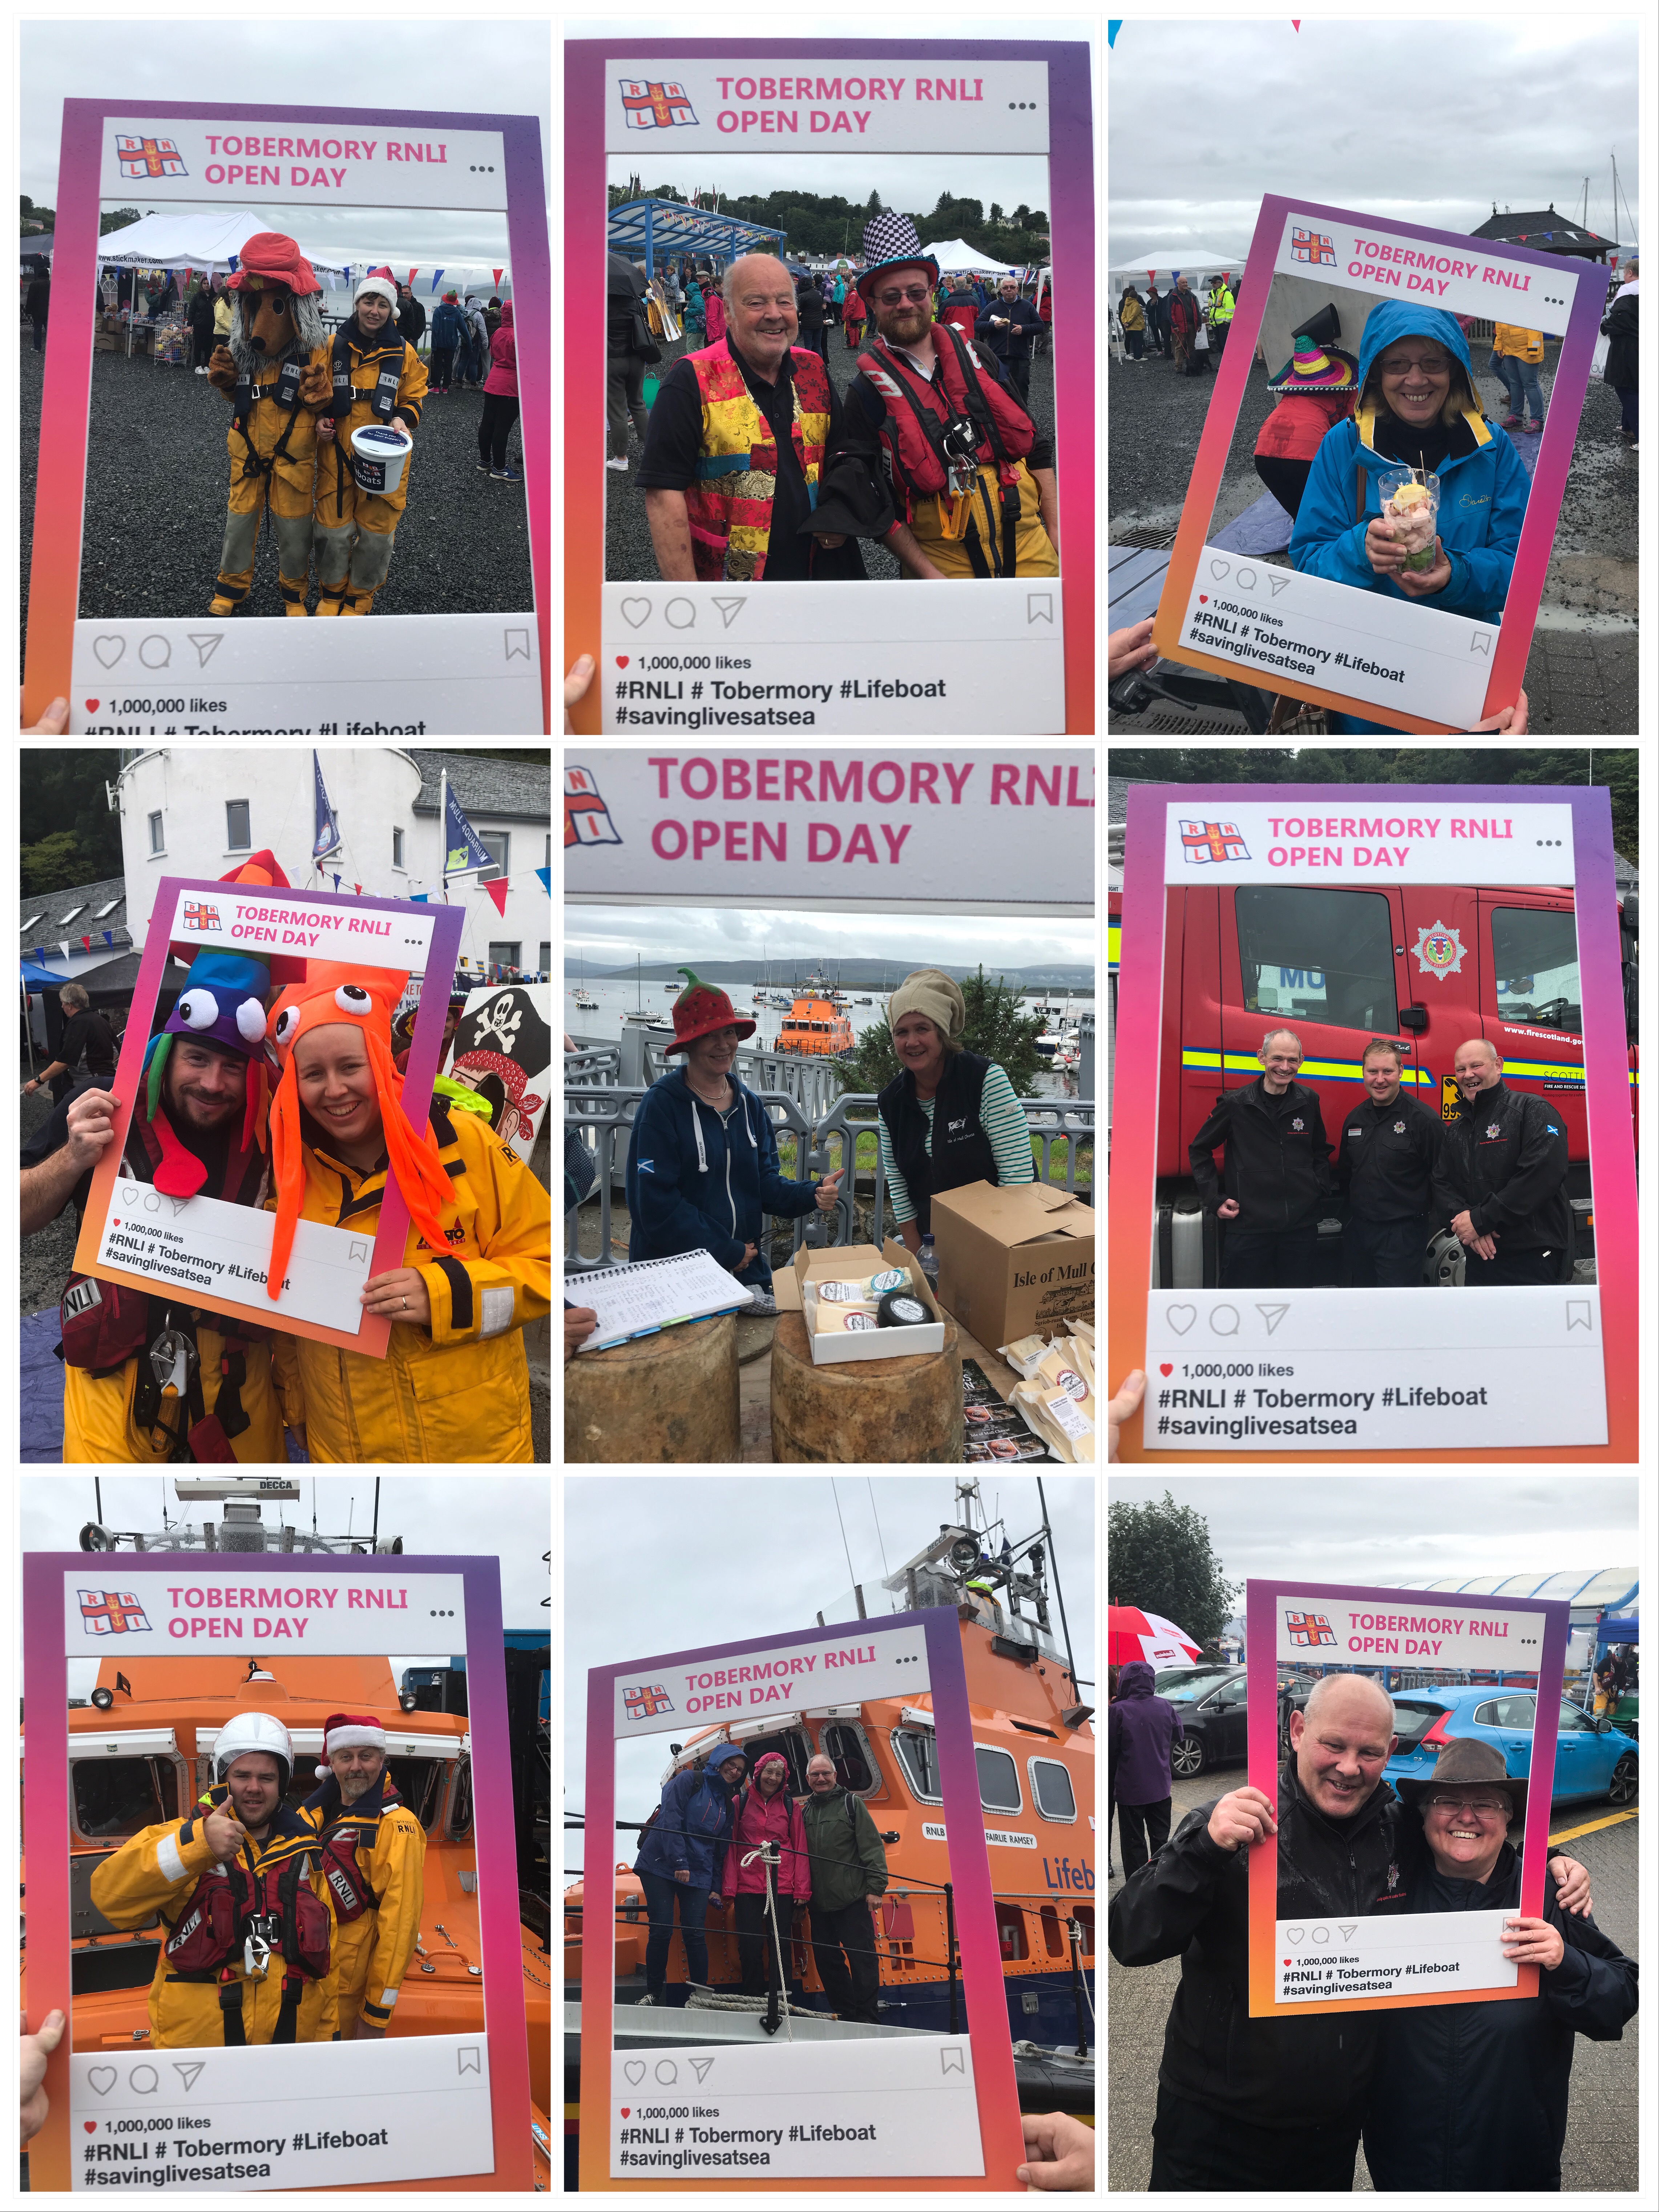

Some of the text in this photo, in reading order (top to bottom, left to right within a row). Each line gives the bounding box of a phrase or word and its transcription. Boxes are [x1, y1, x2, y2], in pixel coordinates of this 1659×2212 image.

[716, 77, 983, 101] TOBERMORY RNLI
[716, 110, 872, 133] OPEN DAY
[206, 136, 447, 163] TOBERMORY RNLI
[205, 165, 347, 187] OPEN DAY
[1354, 239, 1531, 291] TOBERMORY RNLI
[1348, 262, 1450, 296] OPEN DAY
[1213, 599, 1283, 627] 1,000,000 likes
[1190, 628, 1315, 675] #savinglivesatsea
[1194, 611, 1405, 683] #RNLI # Tobermory #Lifeboat
[638, 655, 751, 670] 1,000,000 likes
[615, 678, 946, 701] #RNLI # Tobermory #Lifeboat
[109, 698, 227, 713] 1,000,000 likes
[615, 705, 815, 729] #savinglivesatsea
[648, 758, 1095, 806] TOBERMORY RNL
[449, 800, 488, 863] MULL AQUARIUM
[1268, 818, 1513, 838] TOBERMORY RNLI
[651, 819, 911, 864] OPEN DAY
[1268, 847, 1410, 867] OPEN DAY
[236, 905, 392, 936] TOBERMORY RNLI
[231, 924, 320, 946] OPEN DAY
[125, 1222, 183, 1243] 1,000,000 likes
[109, 1232, 144, 1251] #RNLI
[148, 1243, 155, 1253] #
[158, 1245, 225, 1274] Tobermory
[106, 1247, 212, 1285] #savinglivesatsea
[1013, 1263, 1087, 1288] Isle of Mull
[1182, 1363, 1294, 1378] 1,000,000 likes
[1158, 1385, 1487, 1410] #RNLI # Tobermory #Lifeboat
[1157, 1416, 1357, 1438] #savinglivesatsea
[167, 1588, 408, 1610] TOBERMORY RNLI
[167, 1618, 309, 1639] OPEN DAY
[1348, 1613, 1508, 1638] TOBERMORY RNLI
[1348, 1636, 1442, 1656] OPEN DAY
[685, 1645, 876, 1691] TOBERMORY RNLI
[686, 1682, 793, 1714] OPEN DAY
[397, 1825, 415, 1834] RNLI
[926, 1826, 1033, 1846] RNLB FAIRLIE RAMSEY
[332, 1872, 355, 1906] RNLI
[172, 1914, 197, 1948] RNLI
[1283, 1962, 1460, 1983] #RNLI # Tobermory #Lifeboat
[1296, 1957, 1337, 1967] 1,000,000
[1283, 1980, 1392, 1995] #savinglivesatsea
[637, 2106, 719, 2120] 1,000,000 likes
[104, 2116, 211, 2134] 1,000,000 likes
[620, 2124, 876, 2145] #RNLI # Tobermory #Lifeboat
[85, 2130, 388, 2162] #RNLI # Tobermory #Lifeboat
[620, 2151, 770, 2170] #savinglivesatsea
[85, 2162, 271, 2187] #savinglivesatsea
